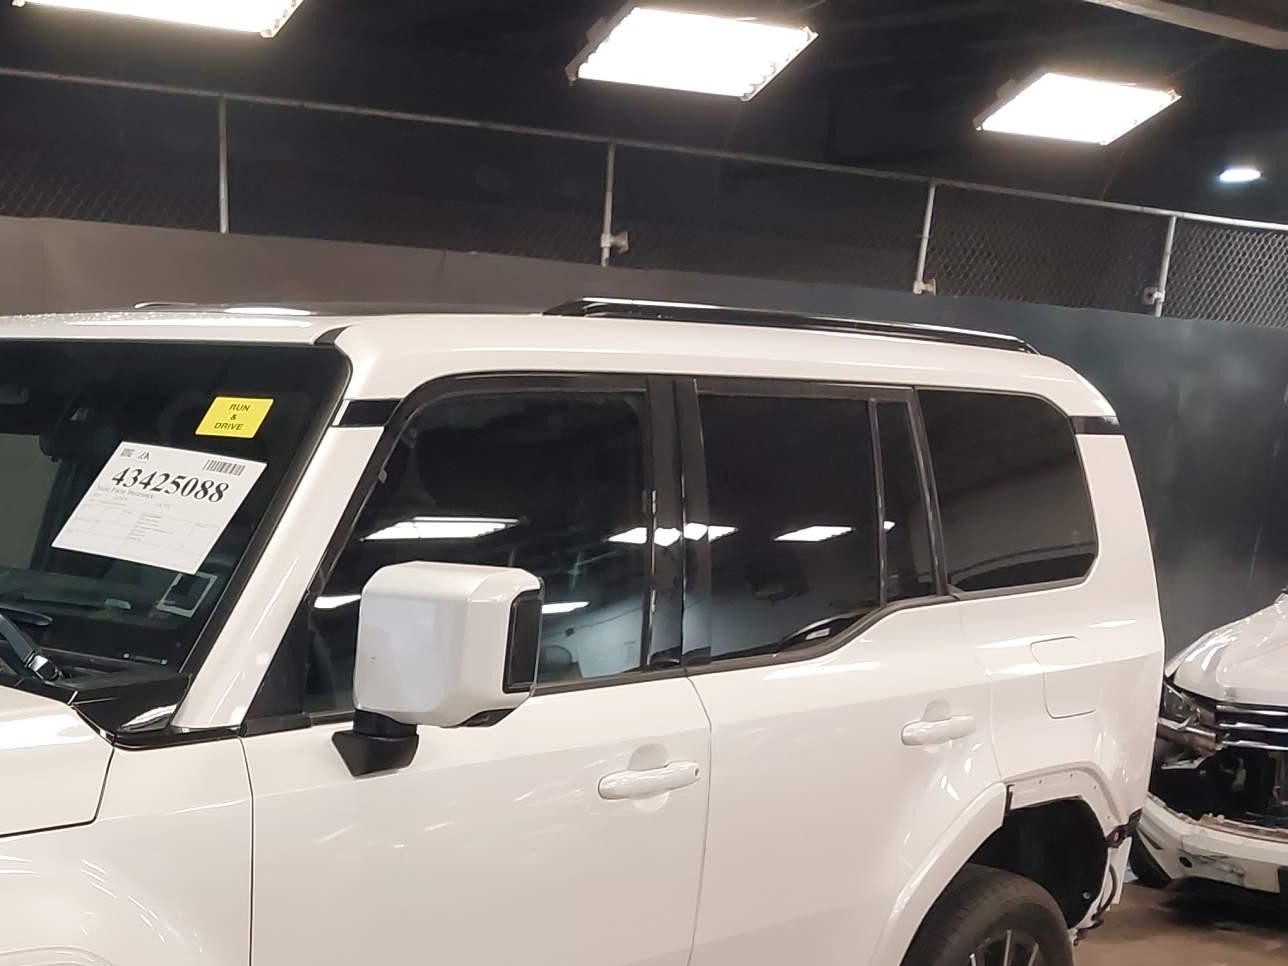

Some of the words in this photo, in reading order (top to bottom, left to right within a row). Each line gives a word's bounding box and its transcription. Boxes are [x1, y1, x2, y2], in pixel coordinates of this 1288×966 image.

[228, 403, 251, 412] RUN
[214, 422, 244, 431] DRIVE
[112, 467, 229, 502] 43425088
